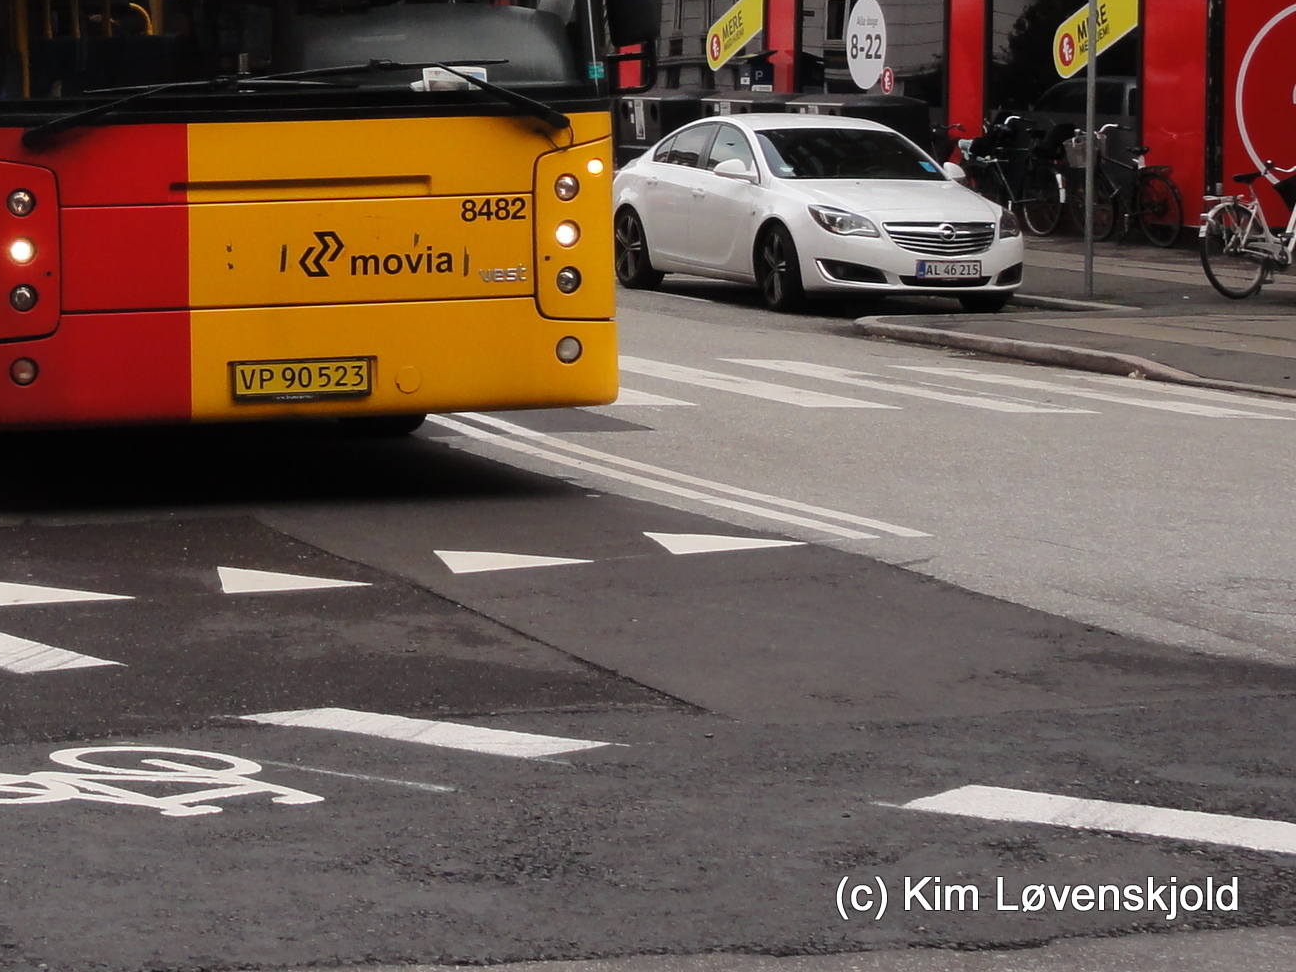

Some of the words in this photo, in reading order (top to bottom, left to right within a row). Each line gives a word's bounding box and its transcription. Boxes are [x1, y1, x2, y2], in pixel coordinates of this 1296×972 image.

[722, 9, 744, 42] MERE
[850, 33, 882, 60] 8-22
[461, 197, 527, 222] 8482
[350, 245, 453, 276] movia
[926, 264, 940, 276] AL
[943, 264, 957, 276] 46
[959, 264, 979, 276] 215
[240, 368, 275, 390] VP
[281, 366, 313, 389] 90
[317, 365, 364, 388] 523
